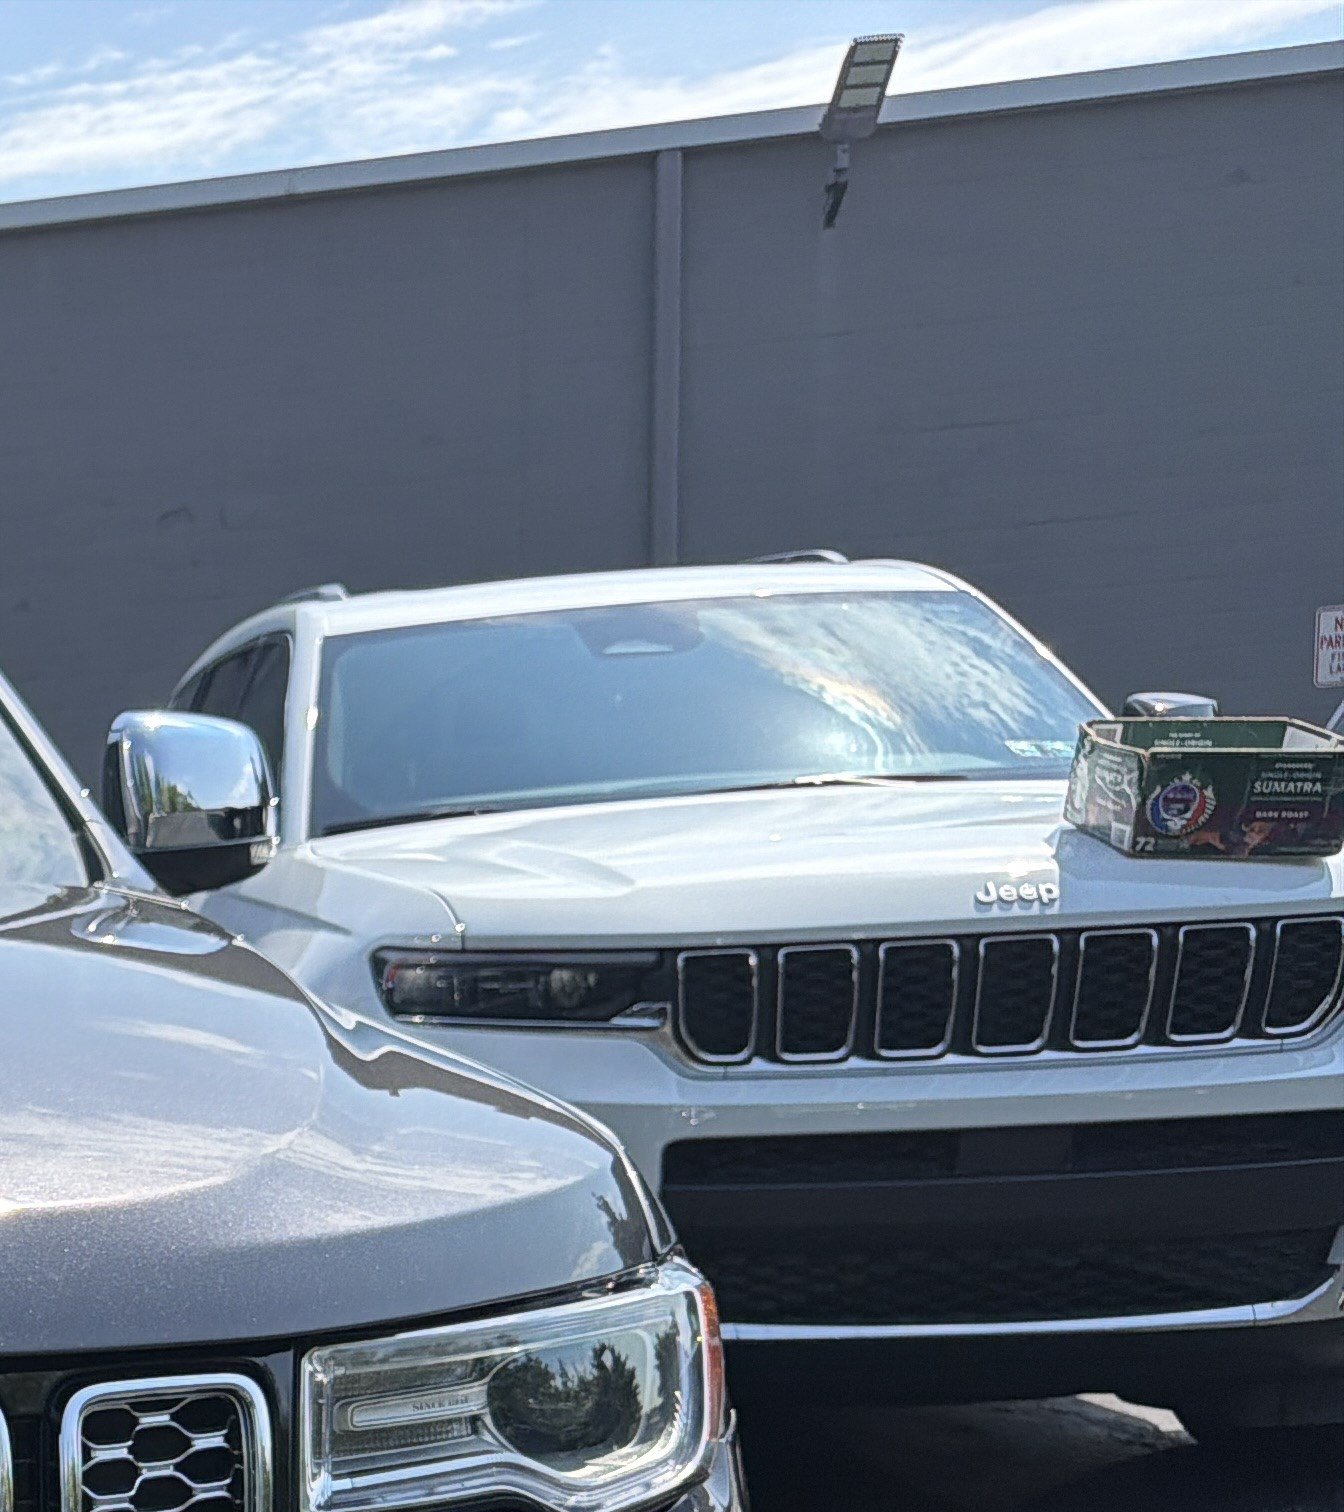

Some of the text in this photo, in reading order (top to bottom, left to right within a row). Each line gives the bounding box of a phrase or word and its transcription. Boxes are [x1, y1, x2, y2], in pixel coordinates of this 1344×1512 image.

[1253, 780, 1322, 794] SUMATRA
[1135, 836, 1156, 851] 72
[974, 880, 1060, 906] Jeep
